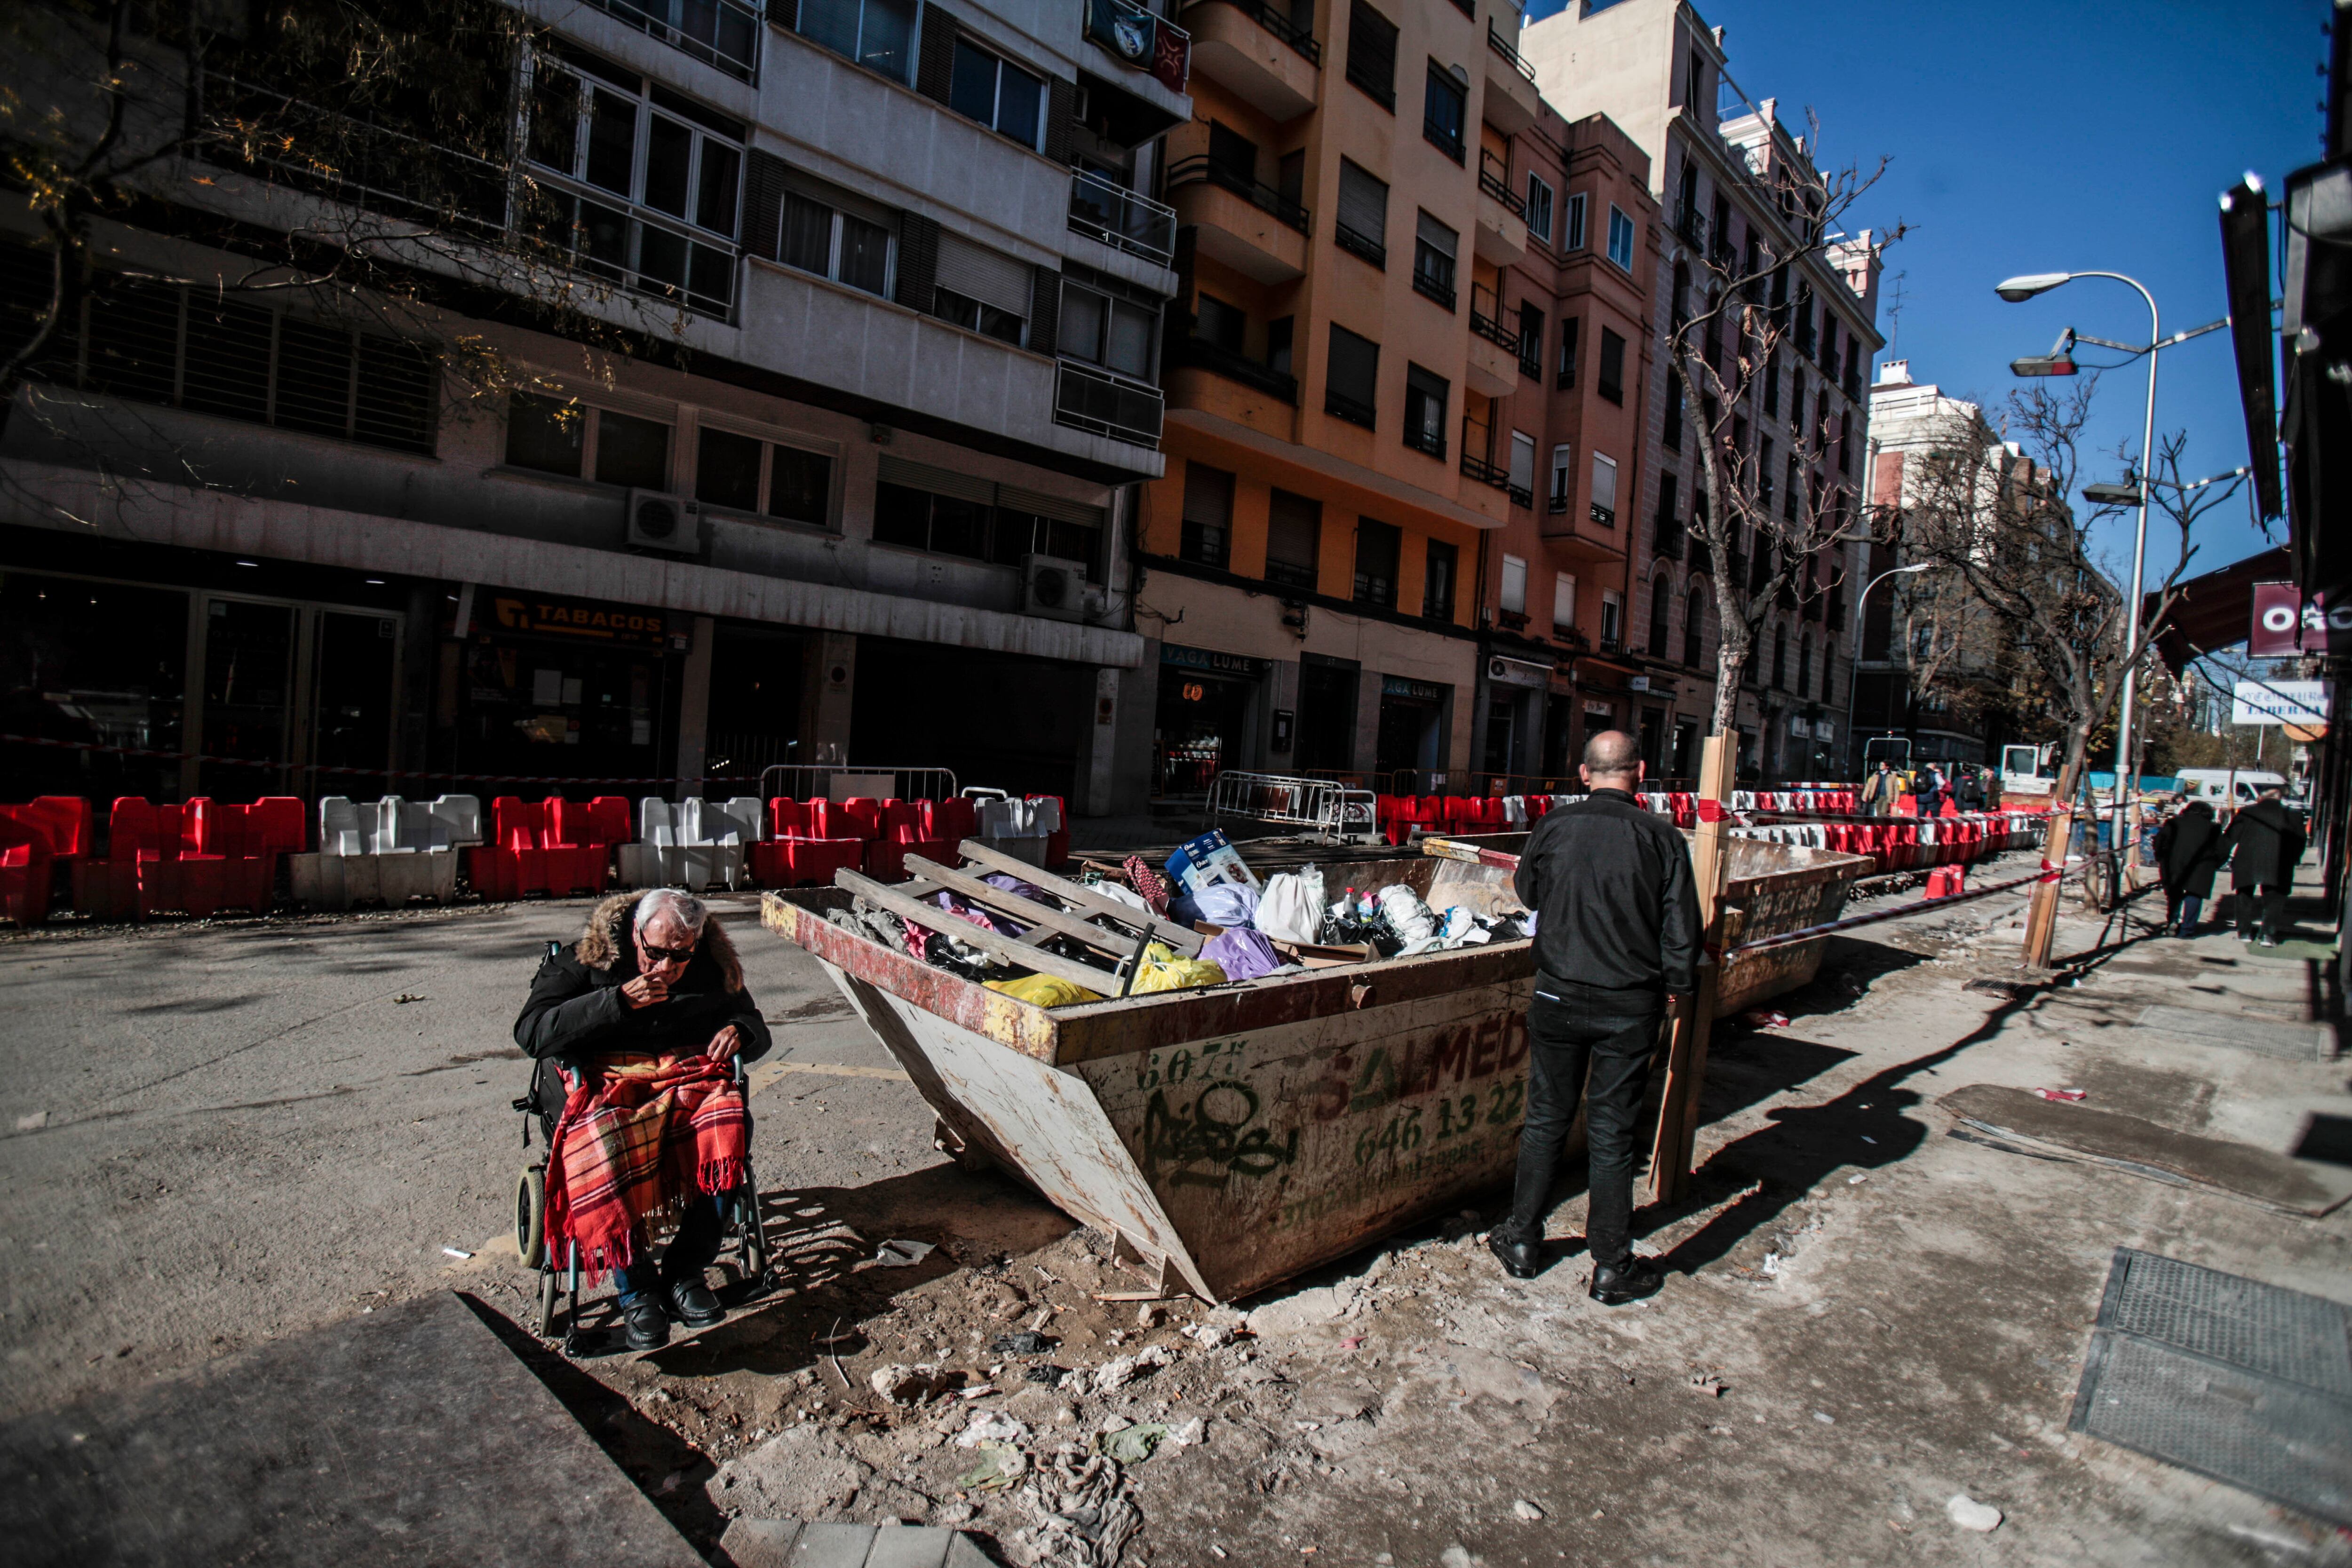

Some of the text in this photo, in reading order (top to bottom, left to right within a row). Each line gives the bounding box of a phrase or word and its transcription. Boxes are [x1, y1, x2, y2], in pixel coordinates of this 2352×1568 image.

[535, 604, 662, 633] TABACOS
[1166, 646, 1250, 671] VAGA LUME
[1412, 684, 1438, 699] LUME
[2246, 706, 2322, 715] TABERNA
[1196, 859, 1208, 868] Oster
[1355, 1108, 1422, 1167] 646
[1437, 1093, 1477, 1141] 13
[1486, 1081, 1524, 1124] 22
